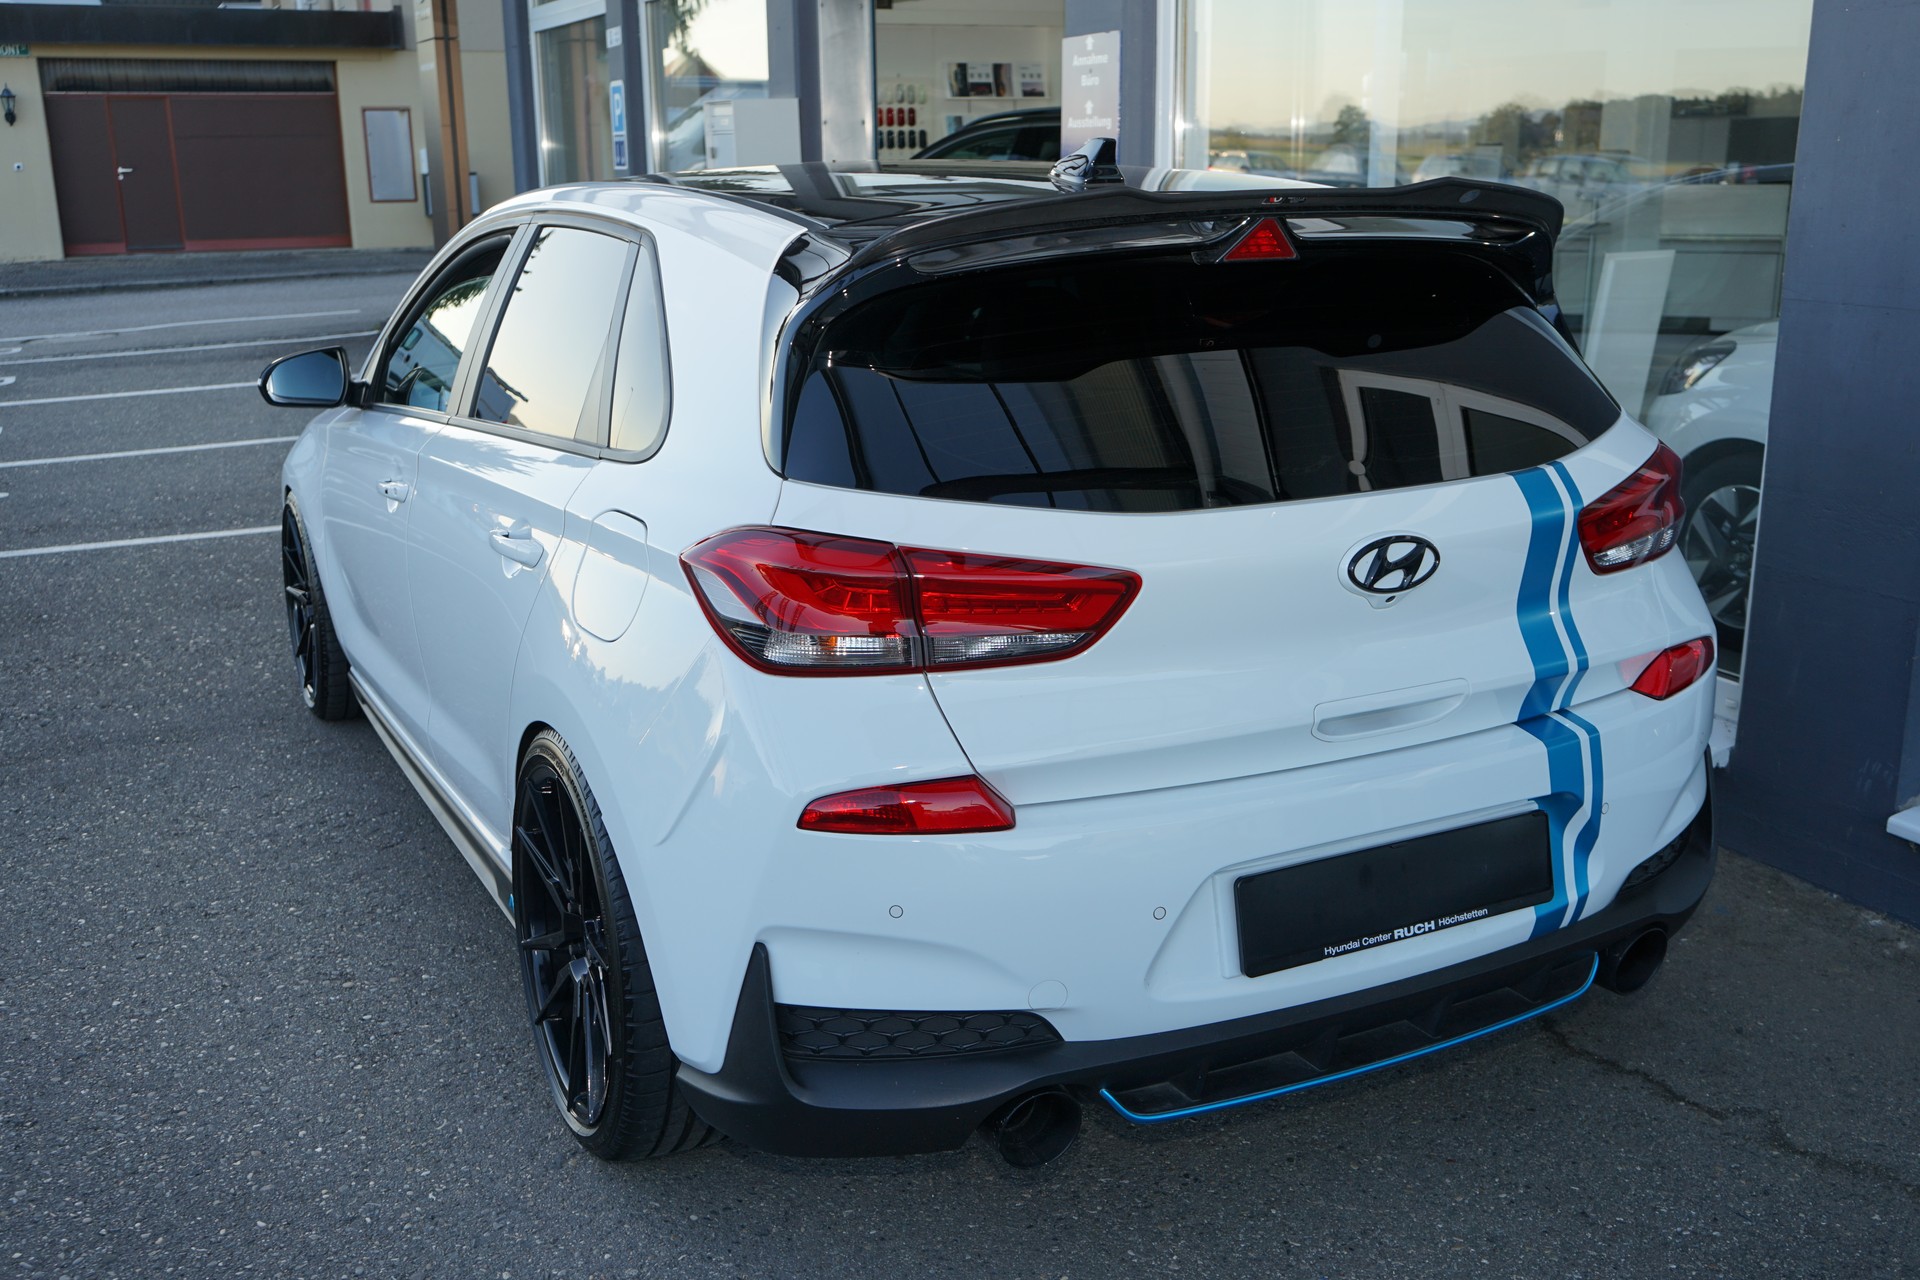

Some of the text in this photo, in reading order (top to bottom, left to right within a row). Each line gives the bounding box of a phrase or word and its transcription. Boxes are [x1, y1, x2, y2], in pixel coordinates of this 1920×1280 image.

[1072, 53, 1108, 66] Annahme
[1081, 74, 1100, 87] Büro
[613, 93, 622, 127] P
[1068, 117, 1112, 130] Ausstellung
[1324, 908, 1488, 956] Hyundai Center RUCH Höchstetten
